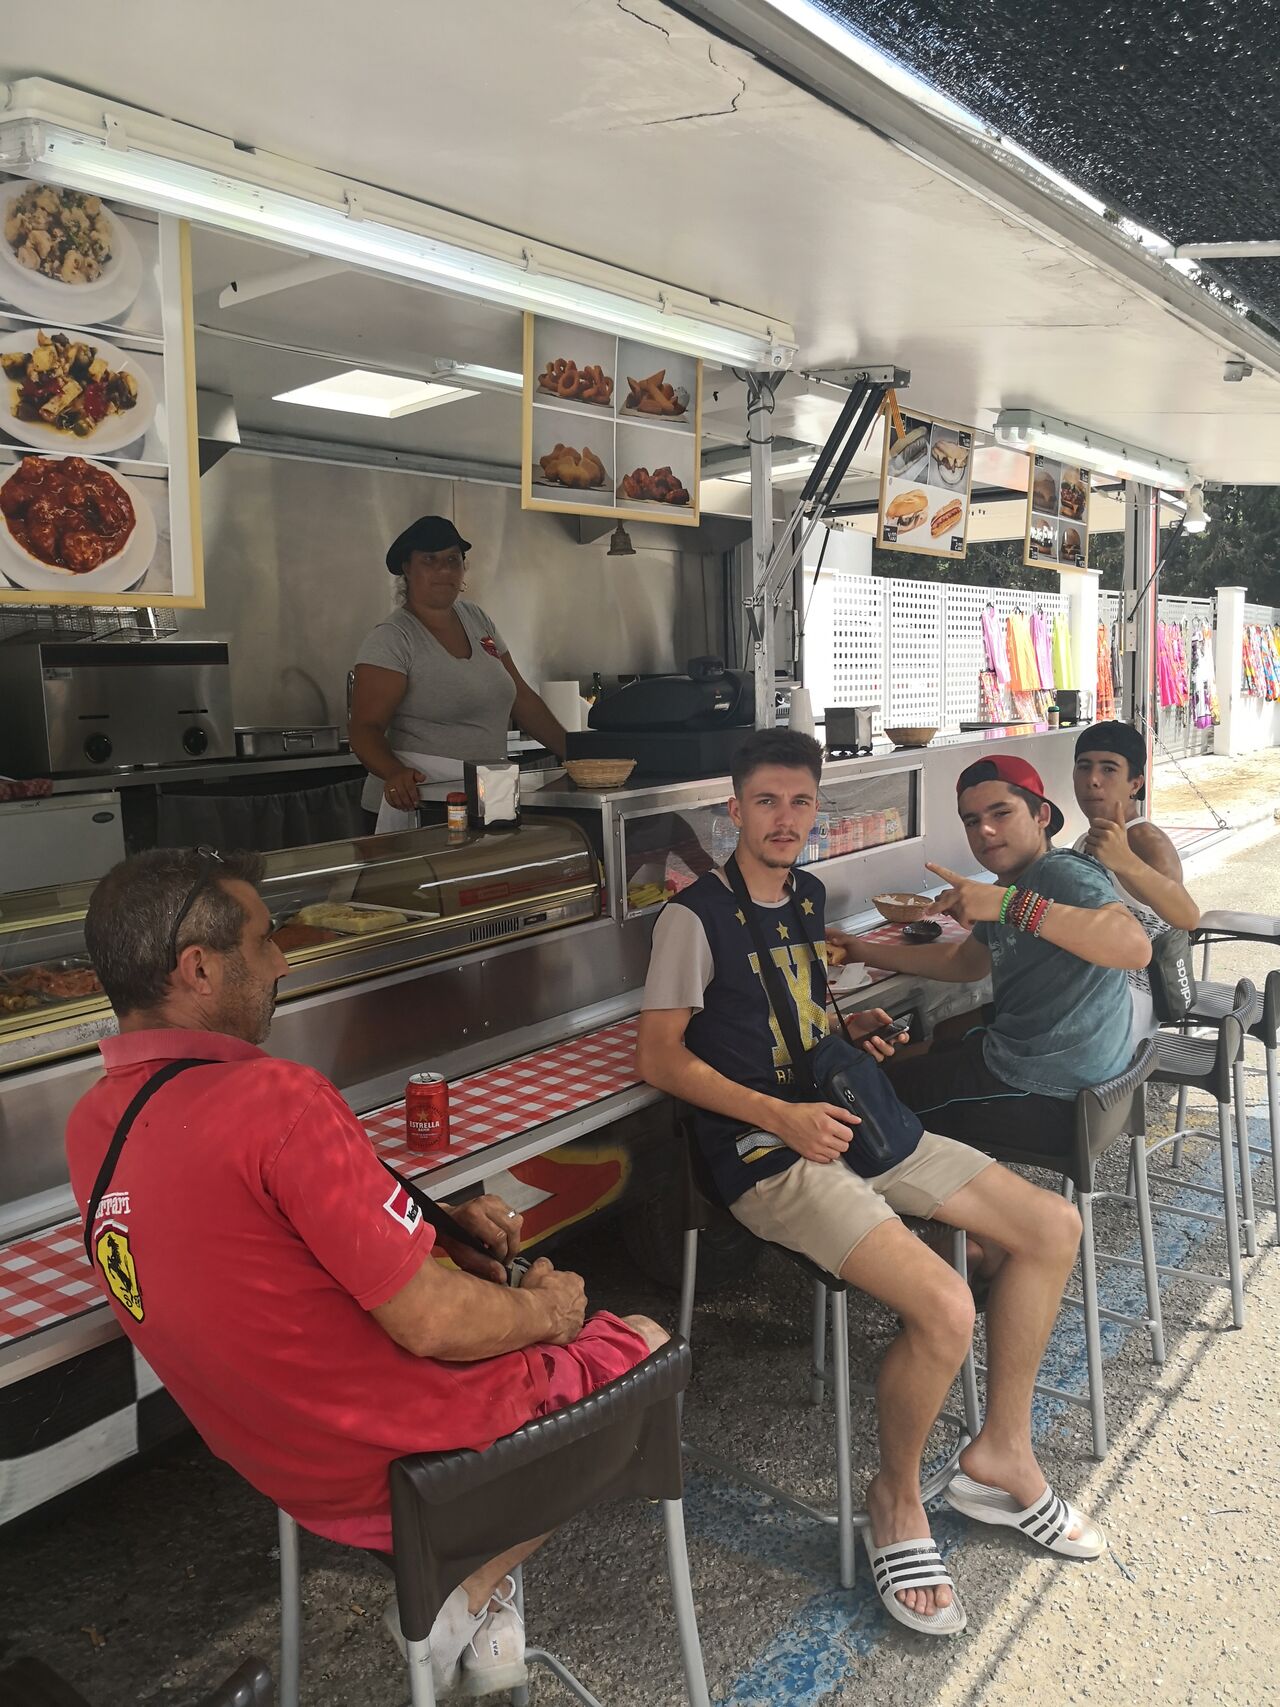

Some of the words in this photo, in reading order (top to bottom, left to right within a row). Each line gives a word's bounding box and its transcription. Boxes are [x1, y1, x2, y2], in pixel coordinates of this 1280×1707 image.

[1176, 958, 1192, 1010] adidas
[409, 1120, 440, 1129] ESTRELLA
[87, 1191, 131, 1219] rrari
